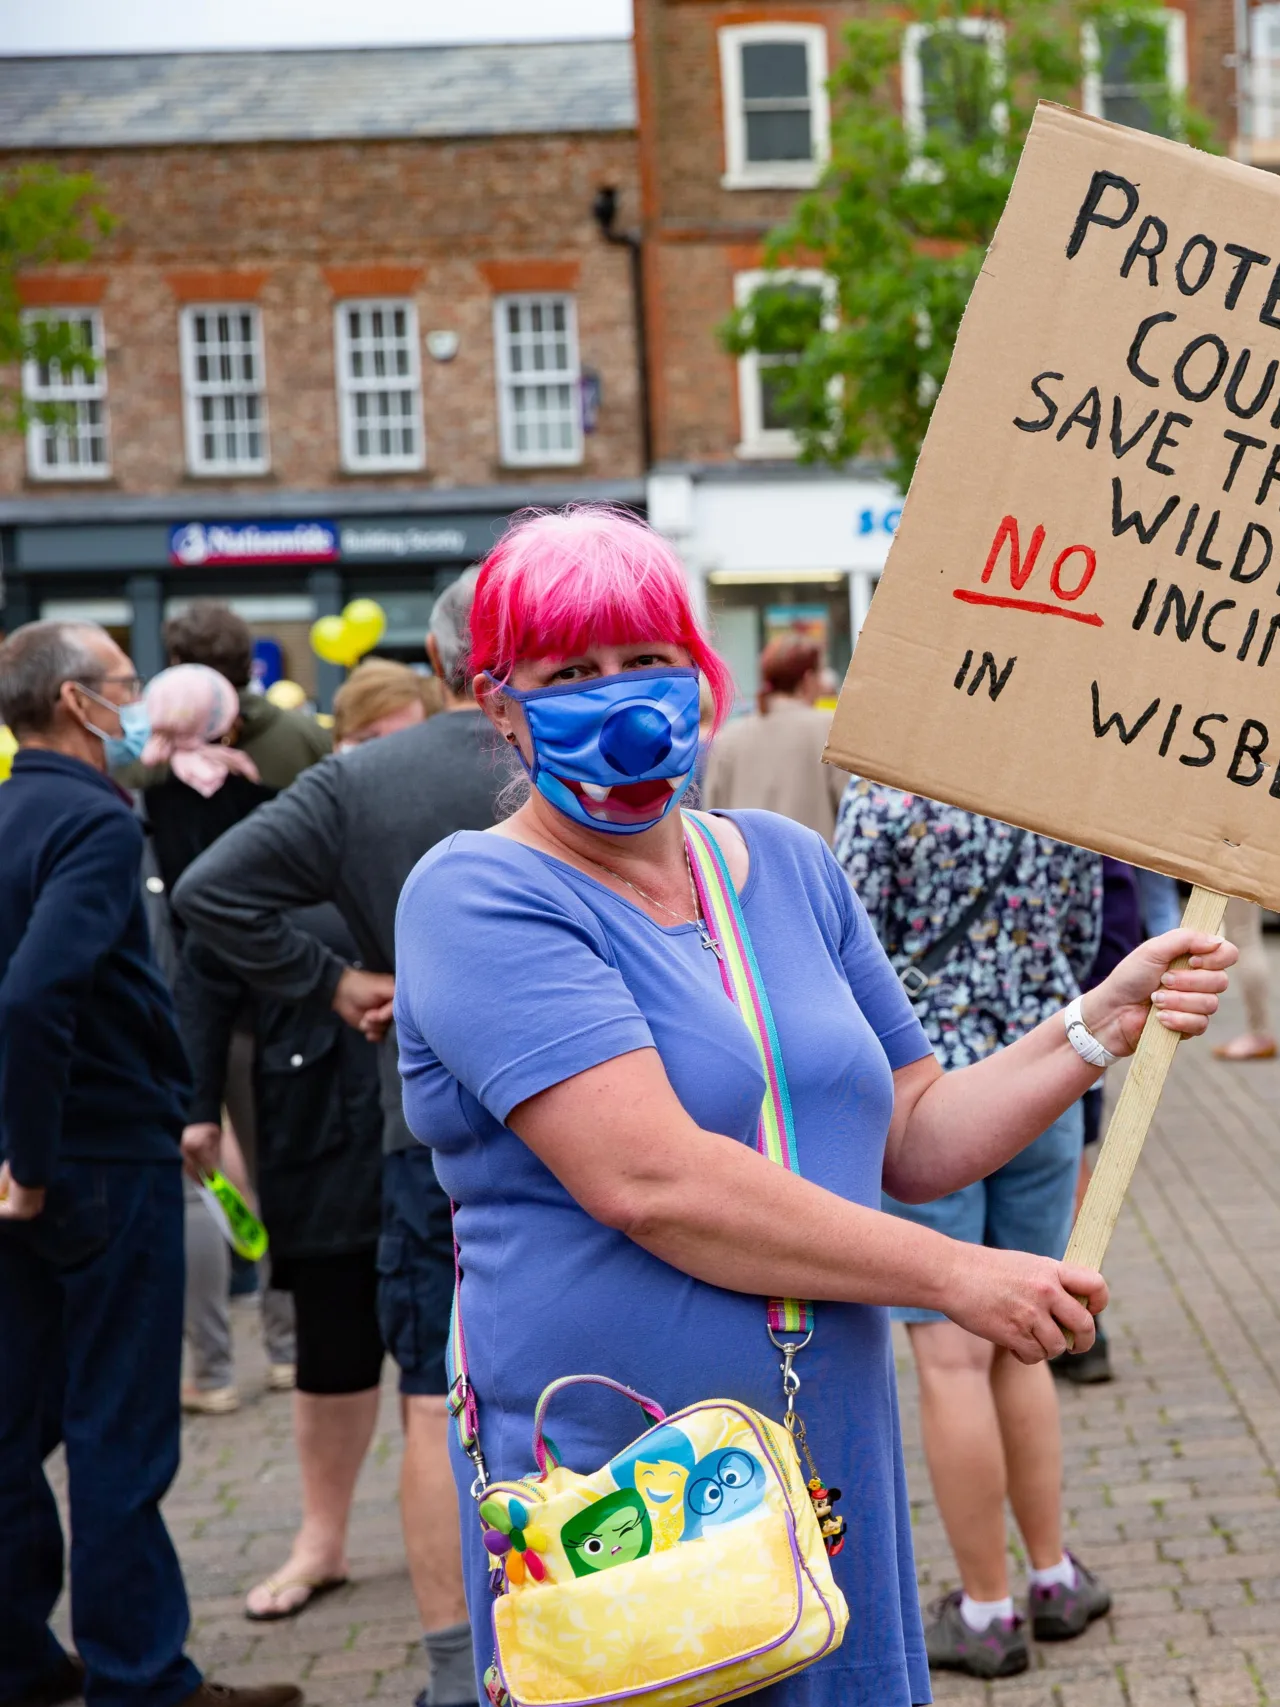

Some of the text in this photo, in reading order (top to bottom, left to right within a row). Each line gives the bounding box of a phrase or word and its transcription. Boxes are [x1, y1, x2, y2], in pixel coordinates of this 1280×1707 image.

[1012, 371, 1193, 476] SAVE
[207, 525, 335, 557] Nationwide
[980, 515, 1097, 601] NO
[953, 649, 1017, 702] IN
